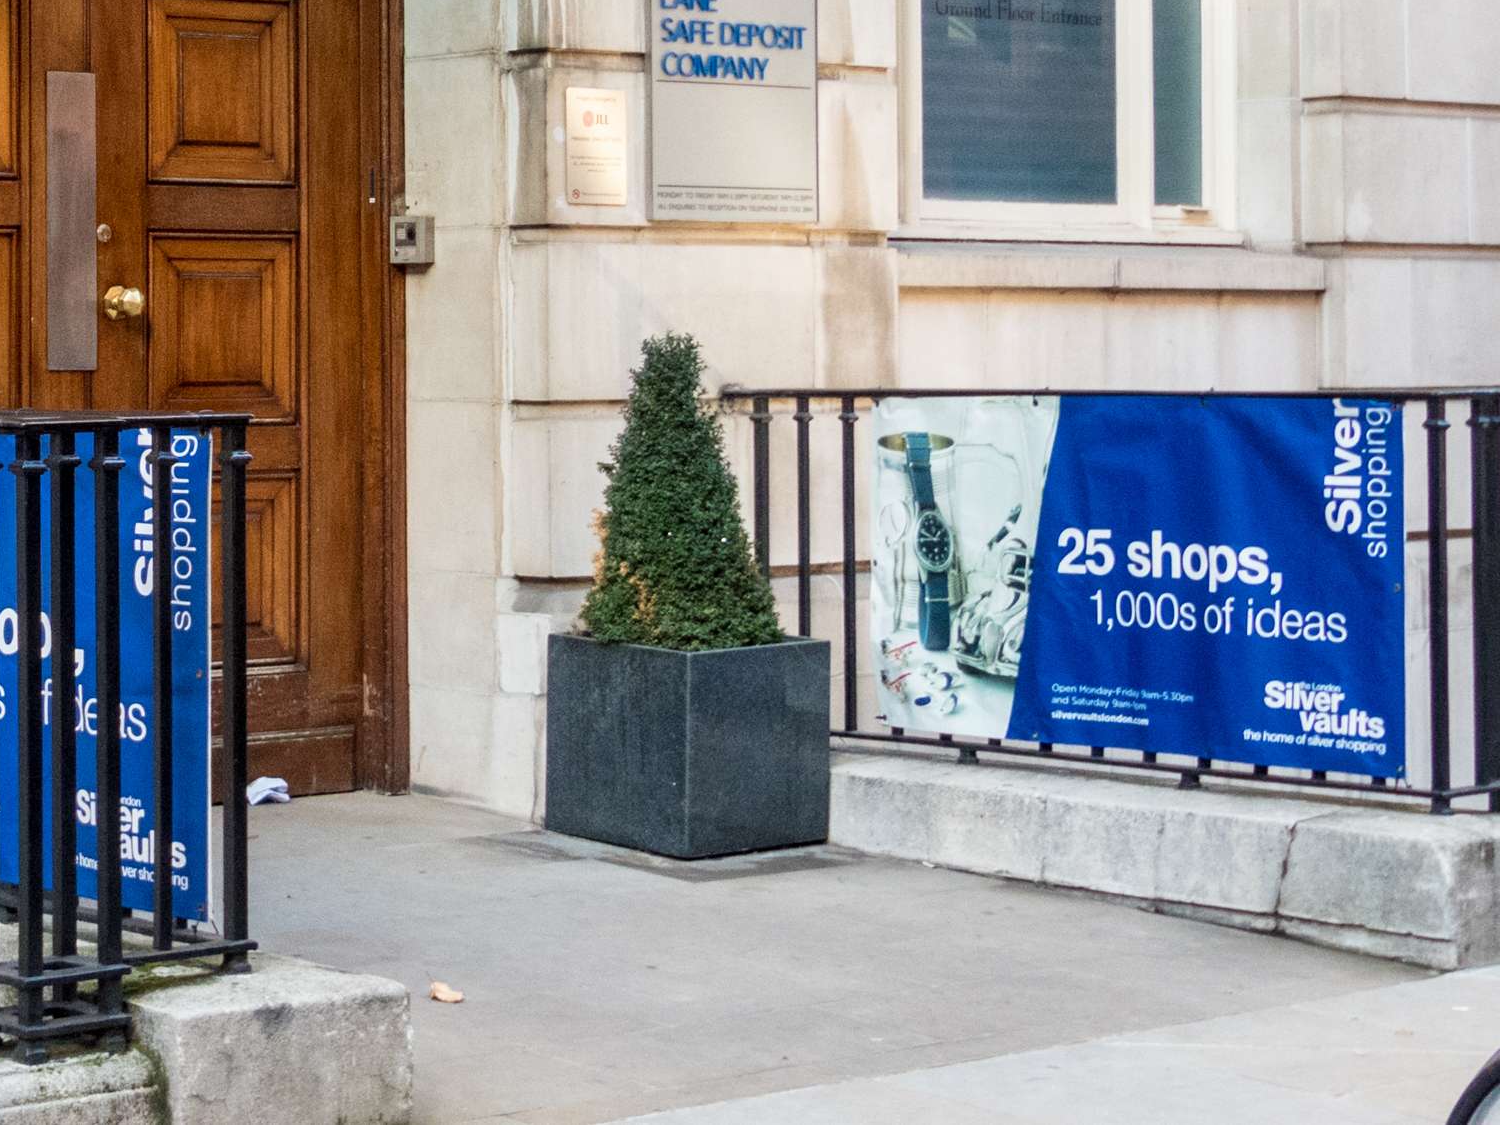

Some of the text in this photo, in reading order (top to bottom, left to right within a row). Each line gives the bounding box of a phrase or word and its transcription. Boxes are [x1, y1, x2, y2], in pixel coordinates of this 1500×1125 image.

[1040, 2, 1103, 27] Entrance
[660, 18, 807, 50] SAFE DEPOSIT
[660, 52, 769, 81] COMPANY
[1324, 398, 1362, 535] Silver
[1362, 407, 1392, 559] shopping
[171, 434, 198, 631] shopping
[1057, 527, 1283, 596] 25 shops,
[1090, 589, 1348, 643] 1,000s of ideas
[1051, 683, 1077, 694] Open
[1078, 685, 1140, 699] Monday-Friday
[1051, 696, 1069, 704] and
[1071, 697, 1110, 709] Saturday
[1263, 680, 1346, 713] Silver
[1311, 683, 1342, 693] London
[1051, 710, 1150, 726] silvervaultslondon.com
[1299, 708, 1386, 739] vaults
[1243, 728, 1387, 756] the home of silver shopping
[76, 789, 145, 833] Sier
[120, 829, 187, 868] auls
